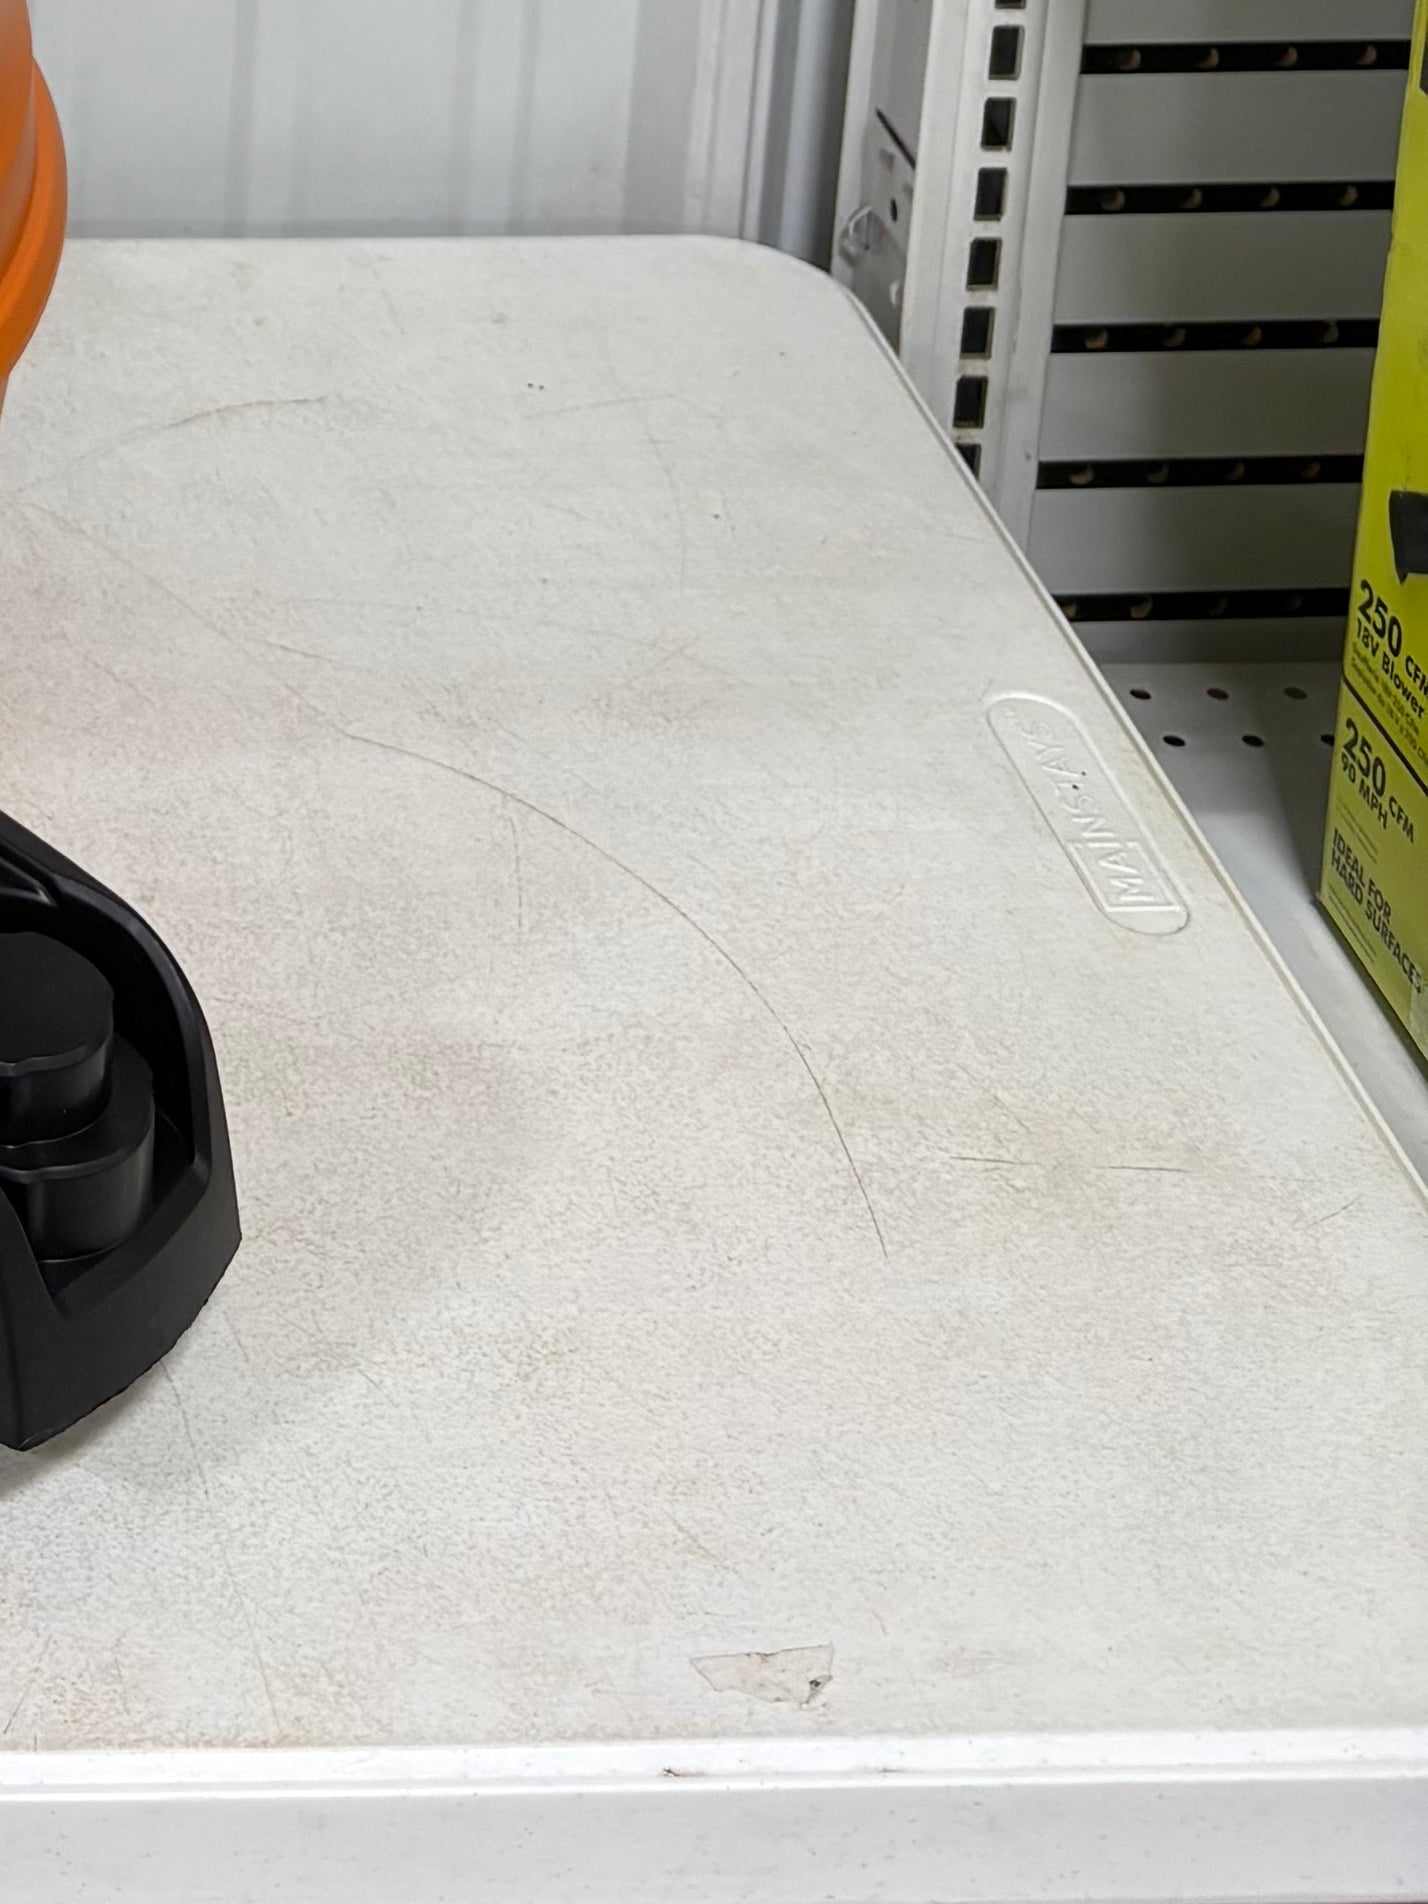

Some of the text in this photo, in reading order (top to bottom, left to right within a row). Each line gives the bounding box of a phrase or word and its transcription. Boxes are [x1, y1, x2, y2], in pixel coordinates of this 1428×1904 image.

[1358, 578, 1403, 658] 250
[1356, 617, 1380, 657] 18V
[1382, 651, 1425, 719] Blower
[1341, 751, 1356, 784] 90
[1358, 780, 1388, 829] MPH
[1343, 717, 1386, 797] 250
[1388, 796, 1415, 844] CFM
[1331, 849, 1363, 907] HARD
[1365, 901, 1422, 994] SURFACES
[1333, 828, 1366, 890] IDEAL
[1368, 877, 1392, 924] FOR
